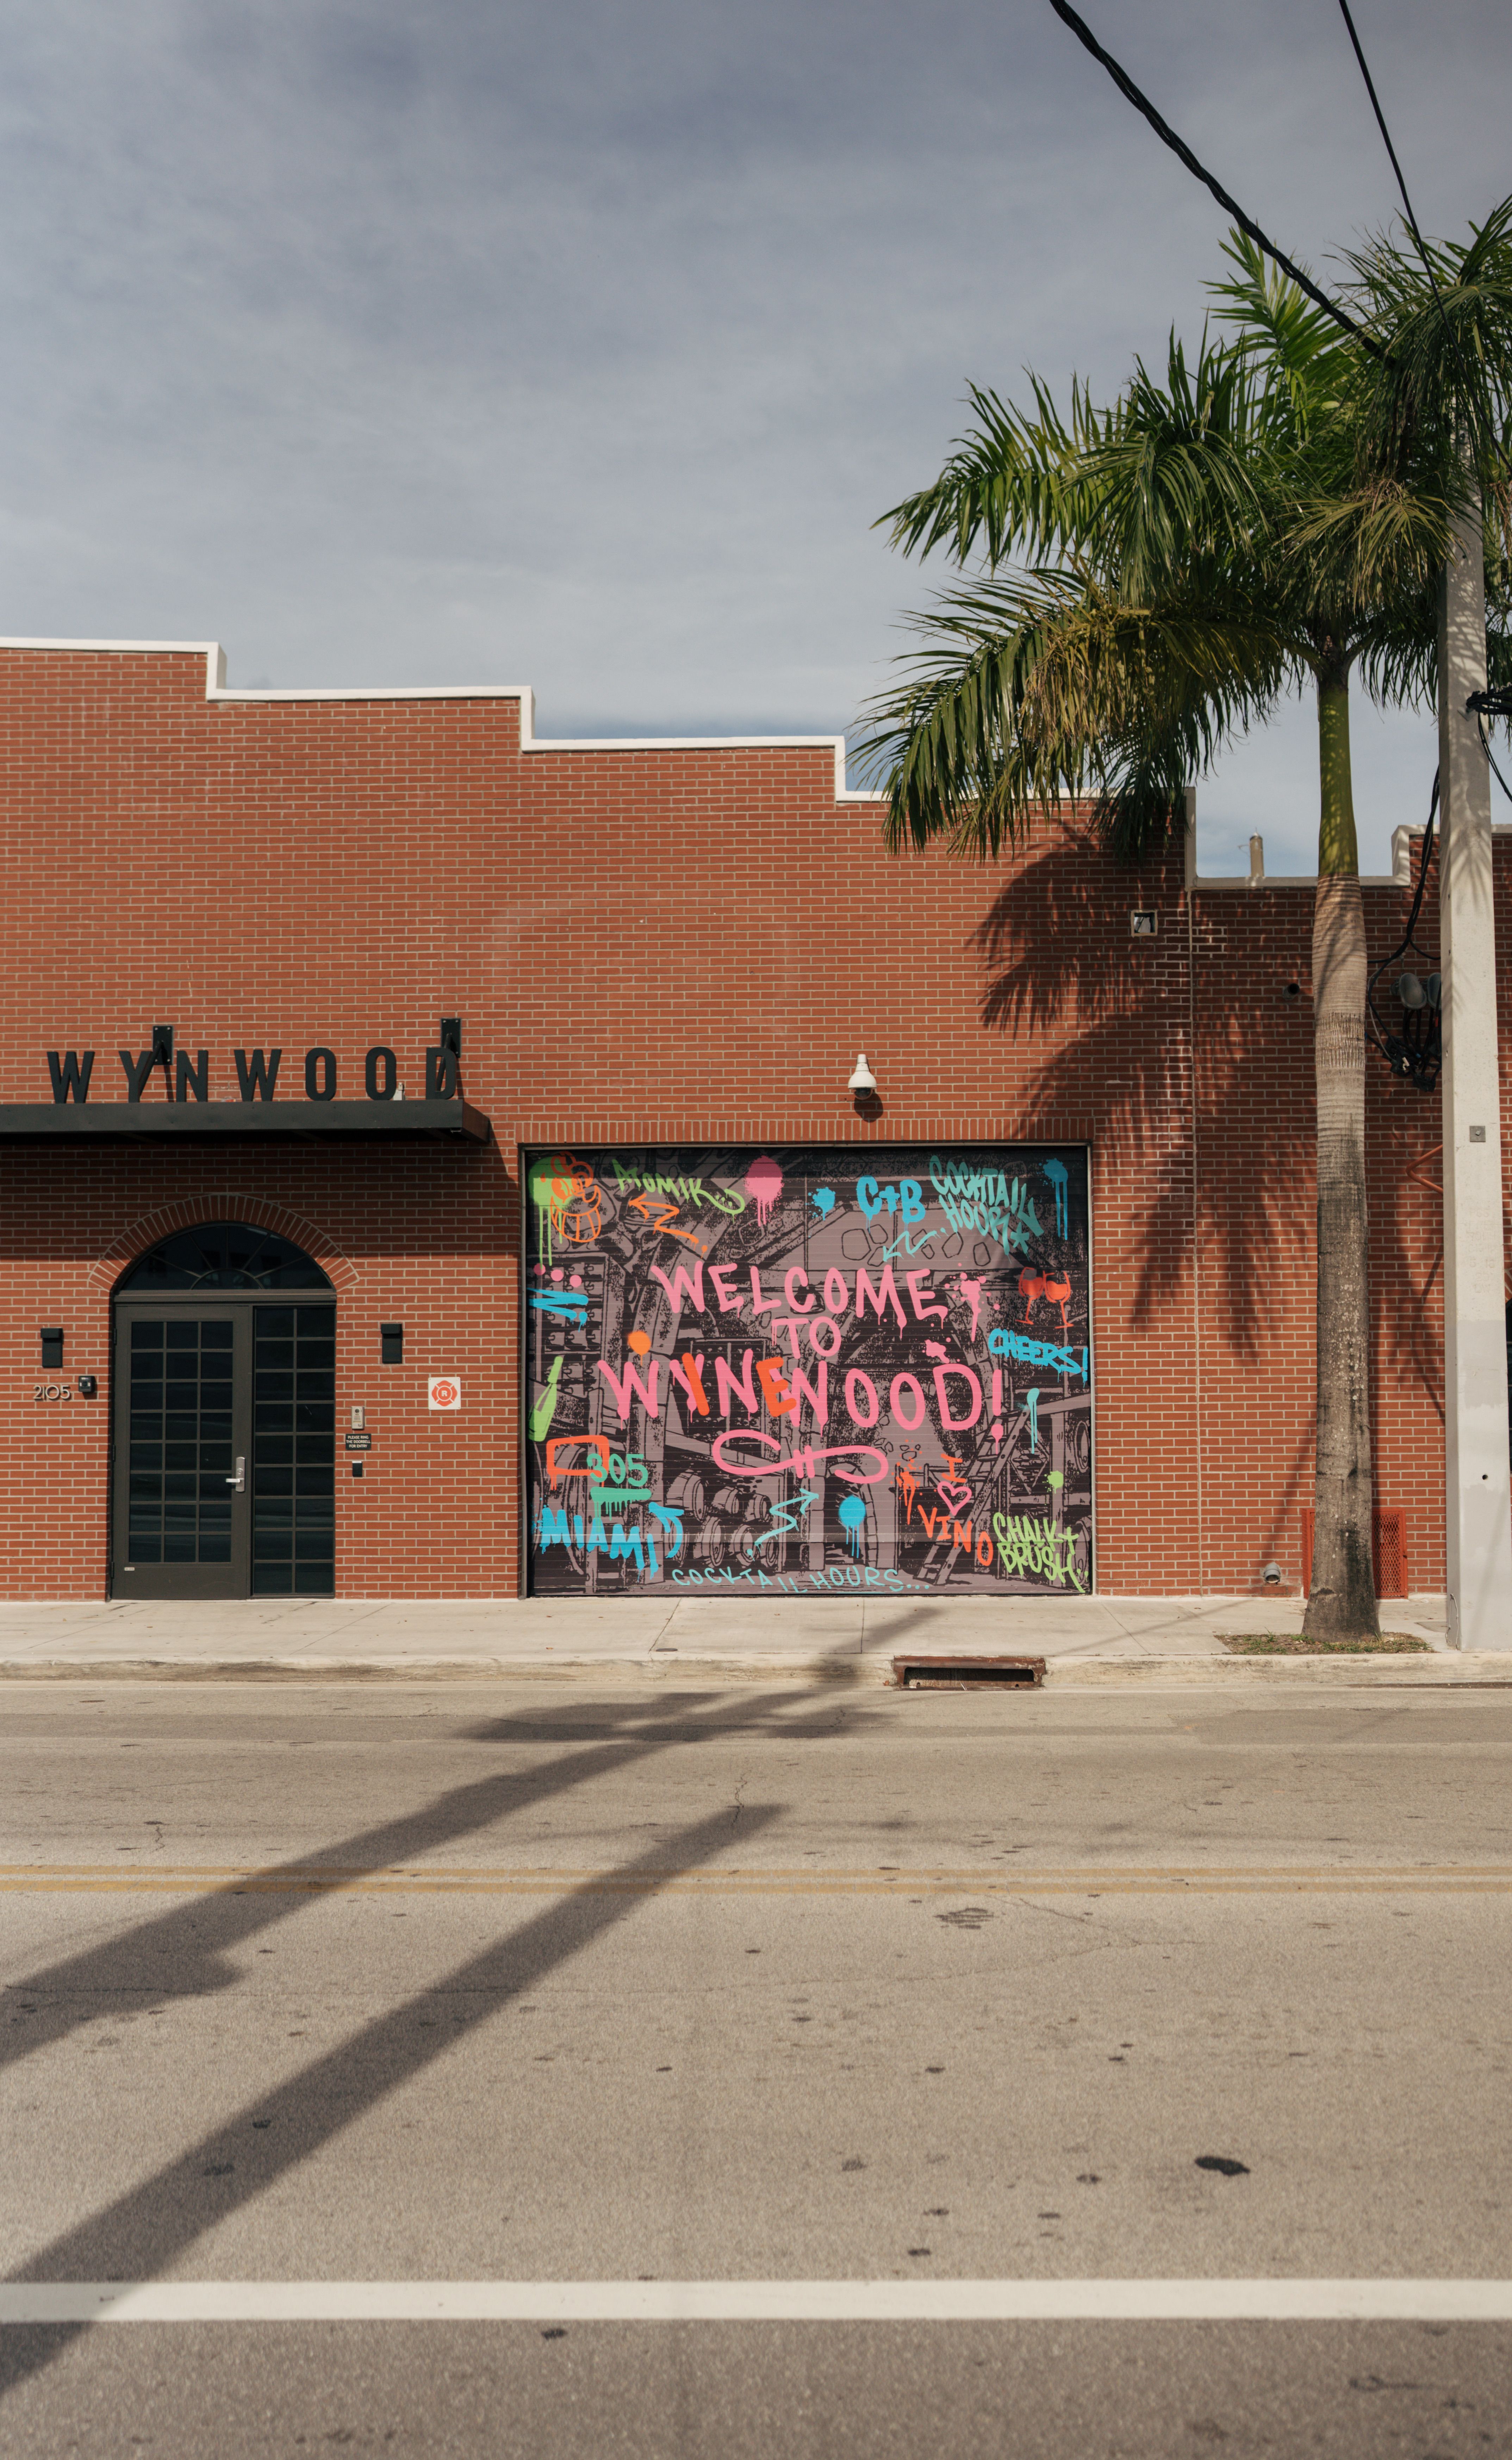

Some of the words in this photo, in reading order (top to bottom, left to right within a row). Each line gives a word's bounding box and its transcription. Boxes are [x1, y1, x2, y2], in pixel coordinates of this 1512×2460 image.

[46, 1047, 457, 1104] WYNWOOD
[612, 1159, 726, 1212] ATOMIK
[929, 1155, 1044, 1237] COCKTAIL
[651, 1261, 948, 1328] WELCOME
[773, 1316, 841, 1359] TO
[988, 1328, 1088, 1381] CHEERS!
[33, 1385, 70, 1399] 2105
[586, 1453, 648, 1486] 305
[941, 1453, 966, 1483] I
[540, 1508, 658, 1573] MIAMI
[917, 1504, 993, 1566] VINO
[672, 1566, 807, 1592] COCKTAIL
